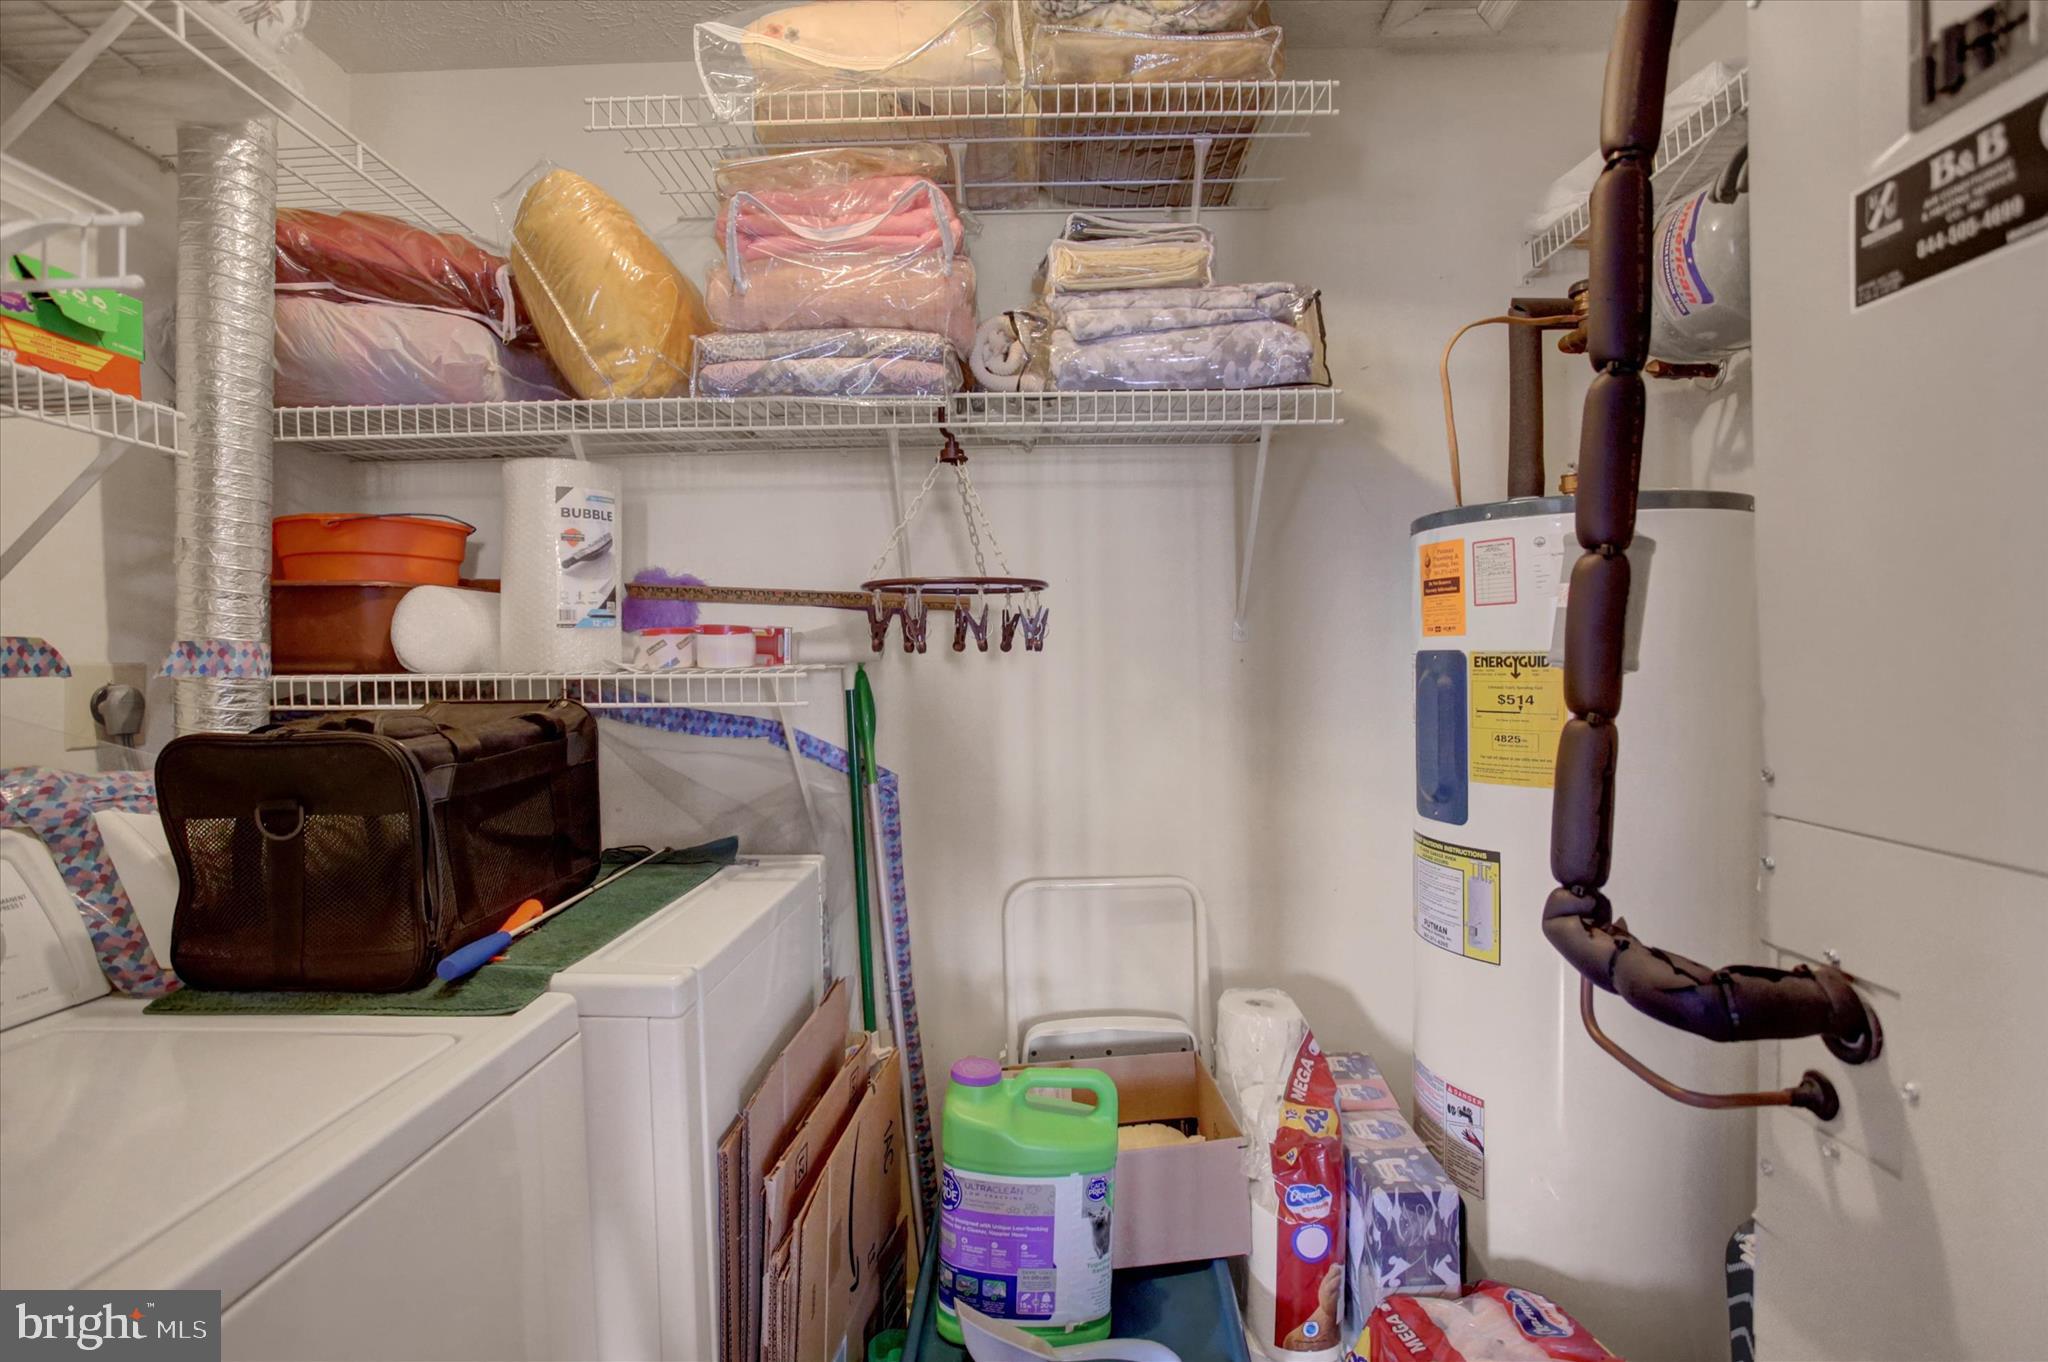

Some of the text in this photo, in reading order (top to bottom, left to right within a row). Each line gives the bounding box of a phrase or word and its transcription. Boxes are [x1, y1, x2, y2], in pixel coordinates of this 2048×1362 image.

[560, 507, 613, 522] BUBBLE
[711, 588, 776, 599] BUILDING
[1474, 655, 1550, 670] ENERGYGUID
[1497, 694, 1534, 706] $514
[1494, 734, 1521, 744] 4825
[1290, 1057, 1314, 1102] MEGA
[1453, 1088, 1483, 1106] DANGER
[1303, 1108, 1329, 1133] 48
[964, 1182, 1024, 1195] ULTRACLEAN
[1386, 1314, 1427, 1354] MEGA
